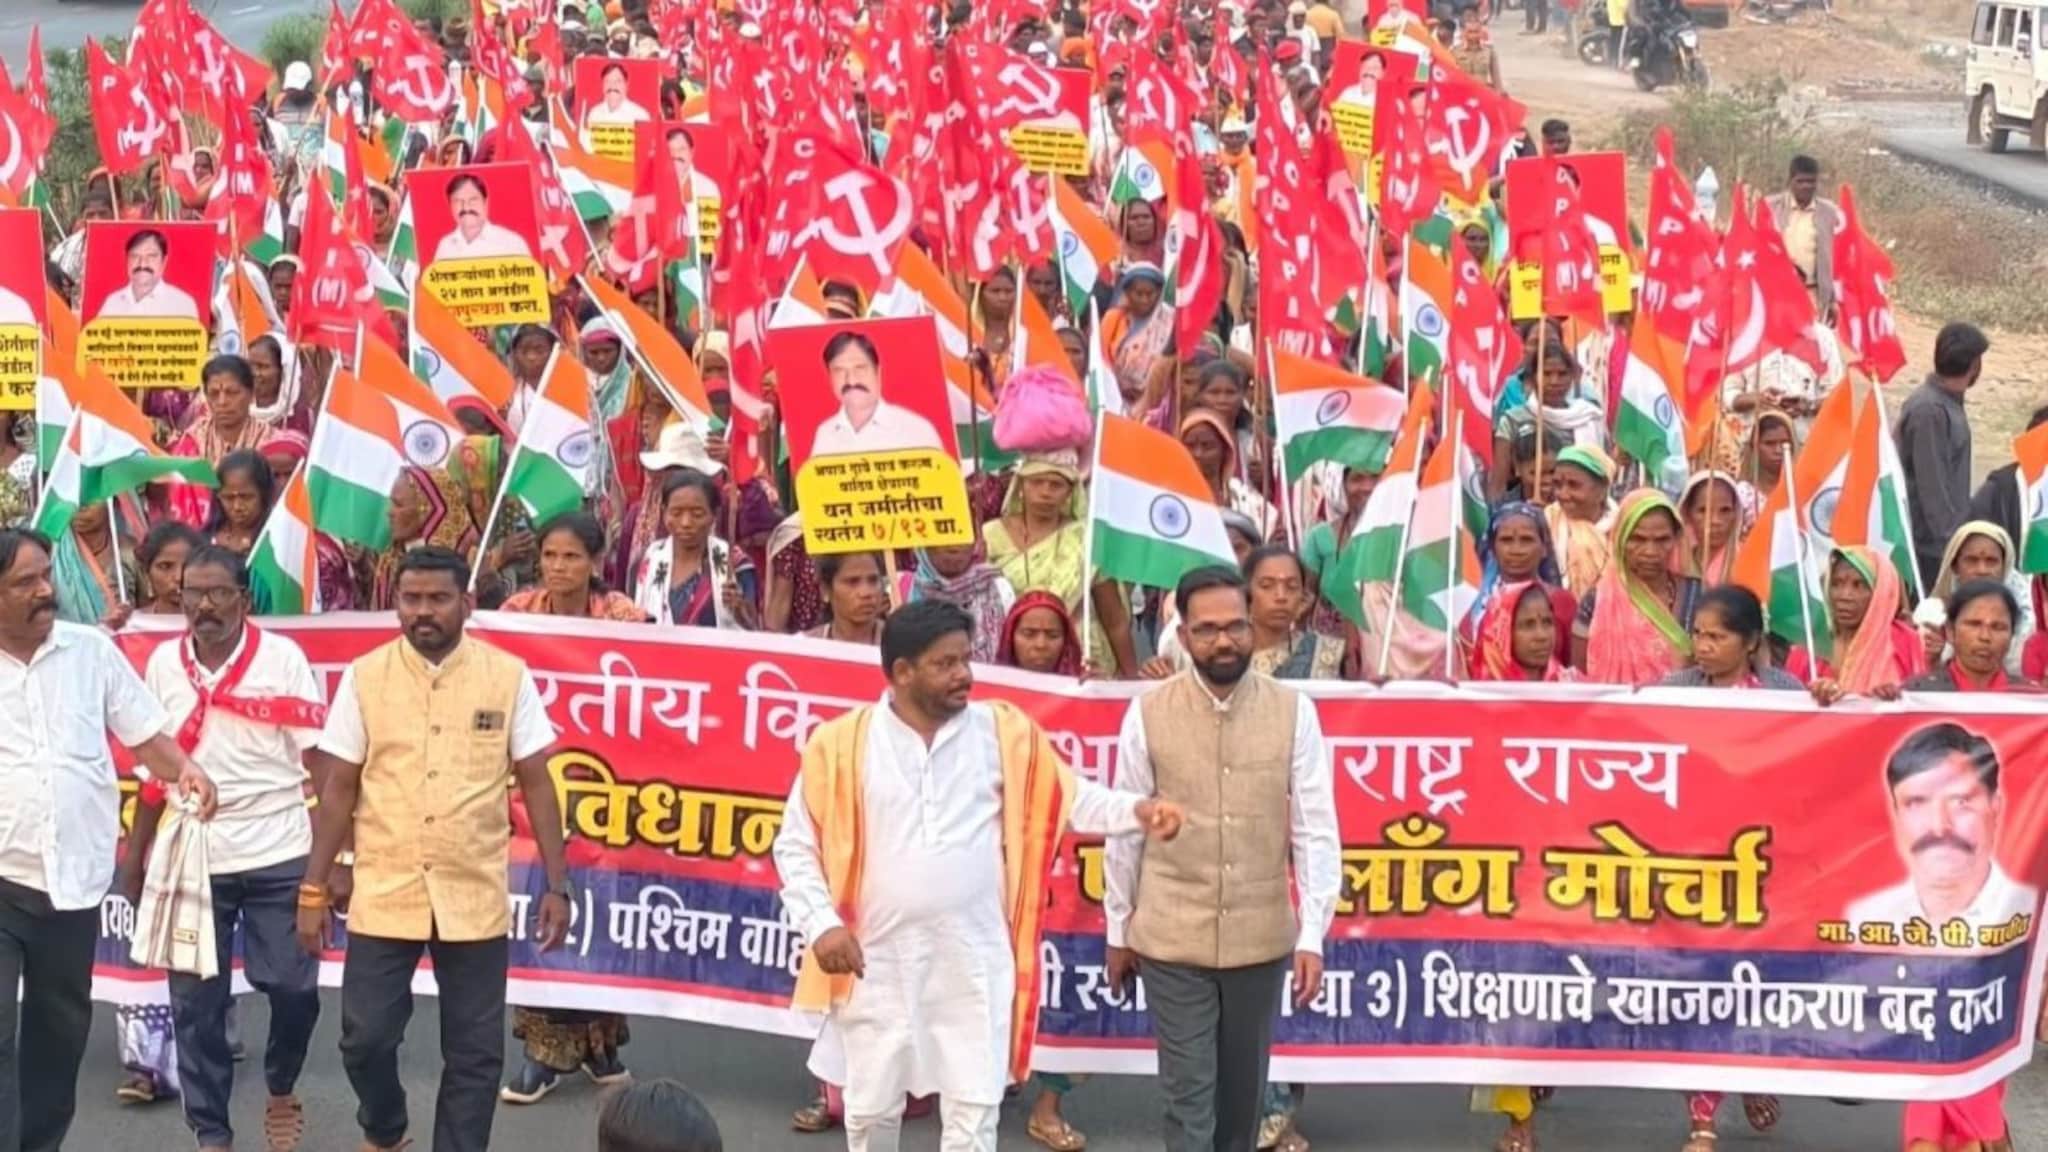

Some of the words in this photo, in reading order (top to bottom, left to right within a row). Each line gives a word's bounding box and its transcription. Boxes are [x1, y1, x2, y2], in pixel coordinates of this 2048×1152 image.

[1502, 737, 1688, 809] राज्य
[1544, 823, 1771, 925] मोर्चा
[608, 885, 732, 960] पश्चिम
[1422, 949, 1597, 1023] शिक्षणाचे
[1607, 959, 1867, 1034] खाजगीकरण
[1878, 965, 1938, 1042] बंद
[1948, 975, 2007, 1036] करा
